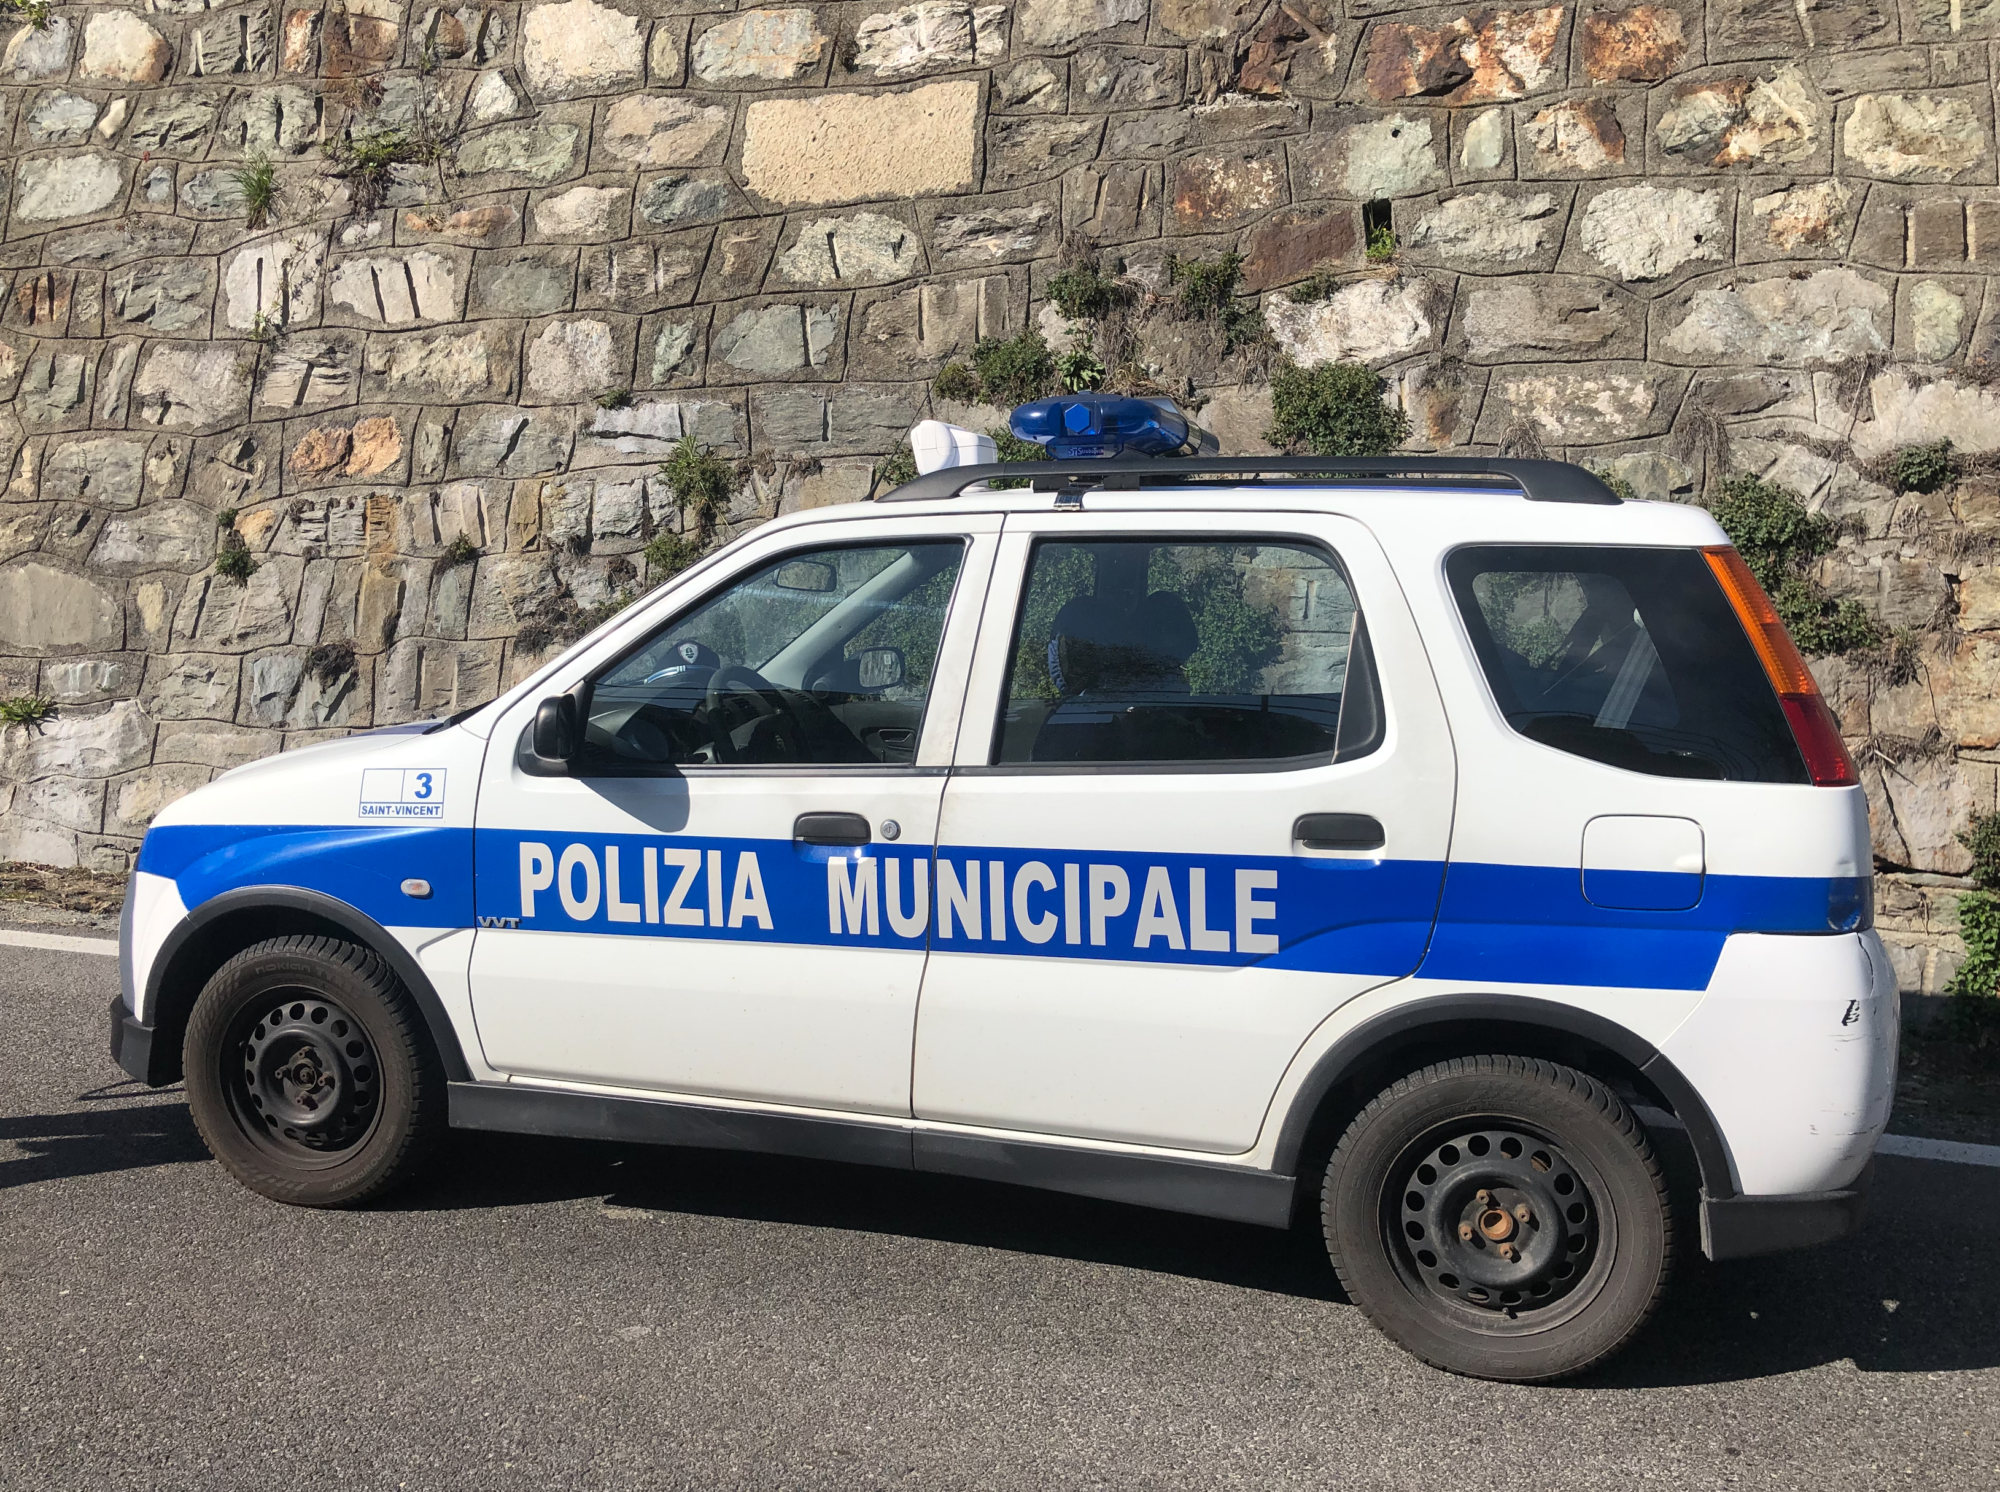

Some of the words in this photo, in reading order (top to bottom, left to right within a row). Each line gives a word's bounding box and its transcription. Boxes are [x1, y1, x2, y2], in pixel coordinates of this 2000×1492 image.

[414, 772, 433, 799] 3
[361, 805, 440, 816] SAINT-VINCENT
[519, 843, 773, 929] POLIZIA
[828, 856, 1279, 954] MUNICIPALE
[478, 916, 520, 929] VVT
